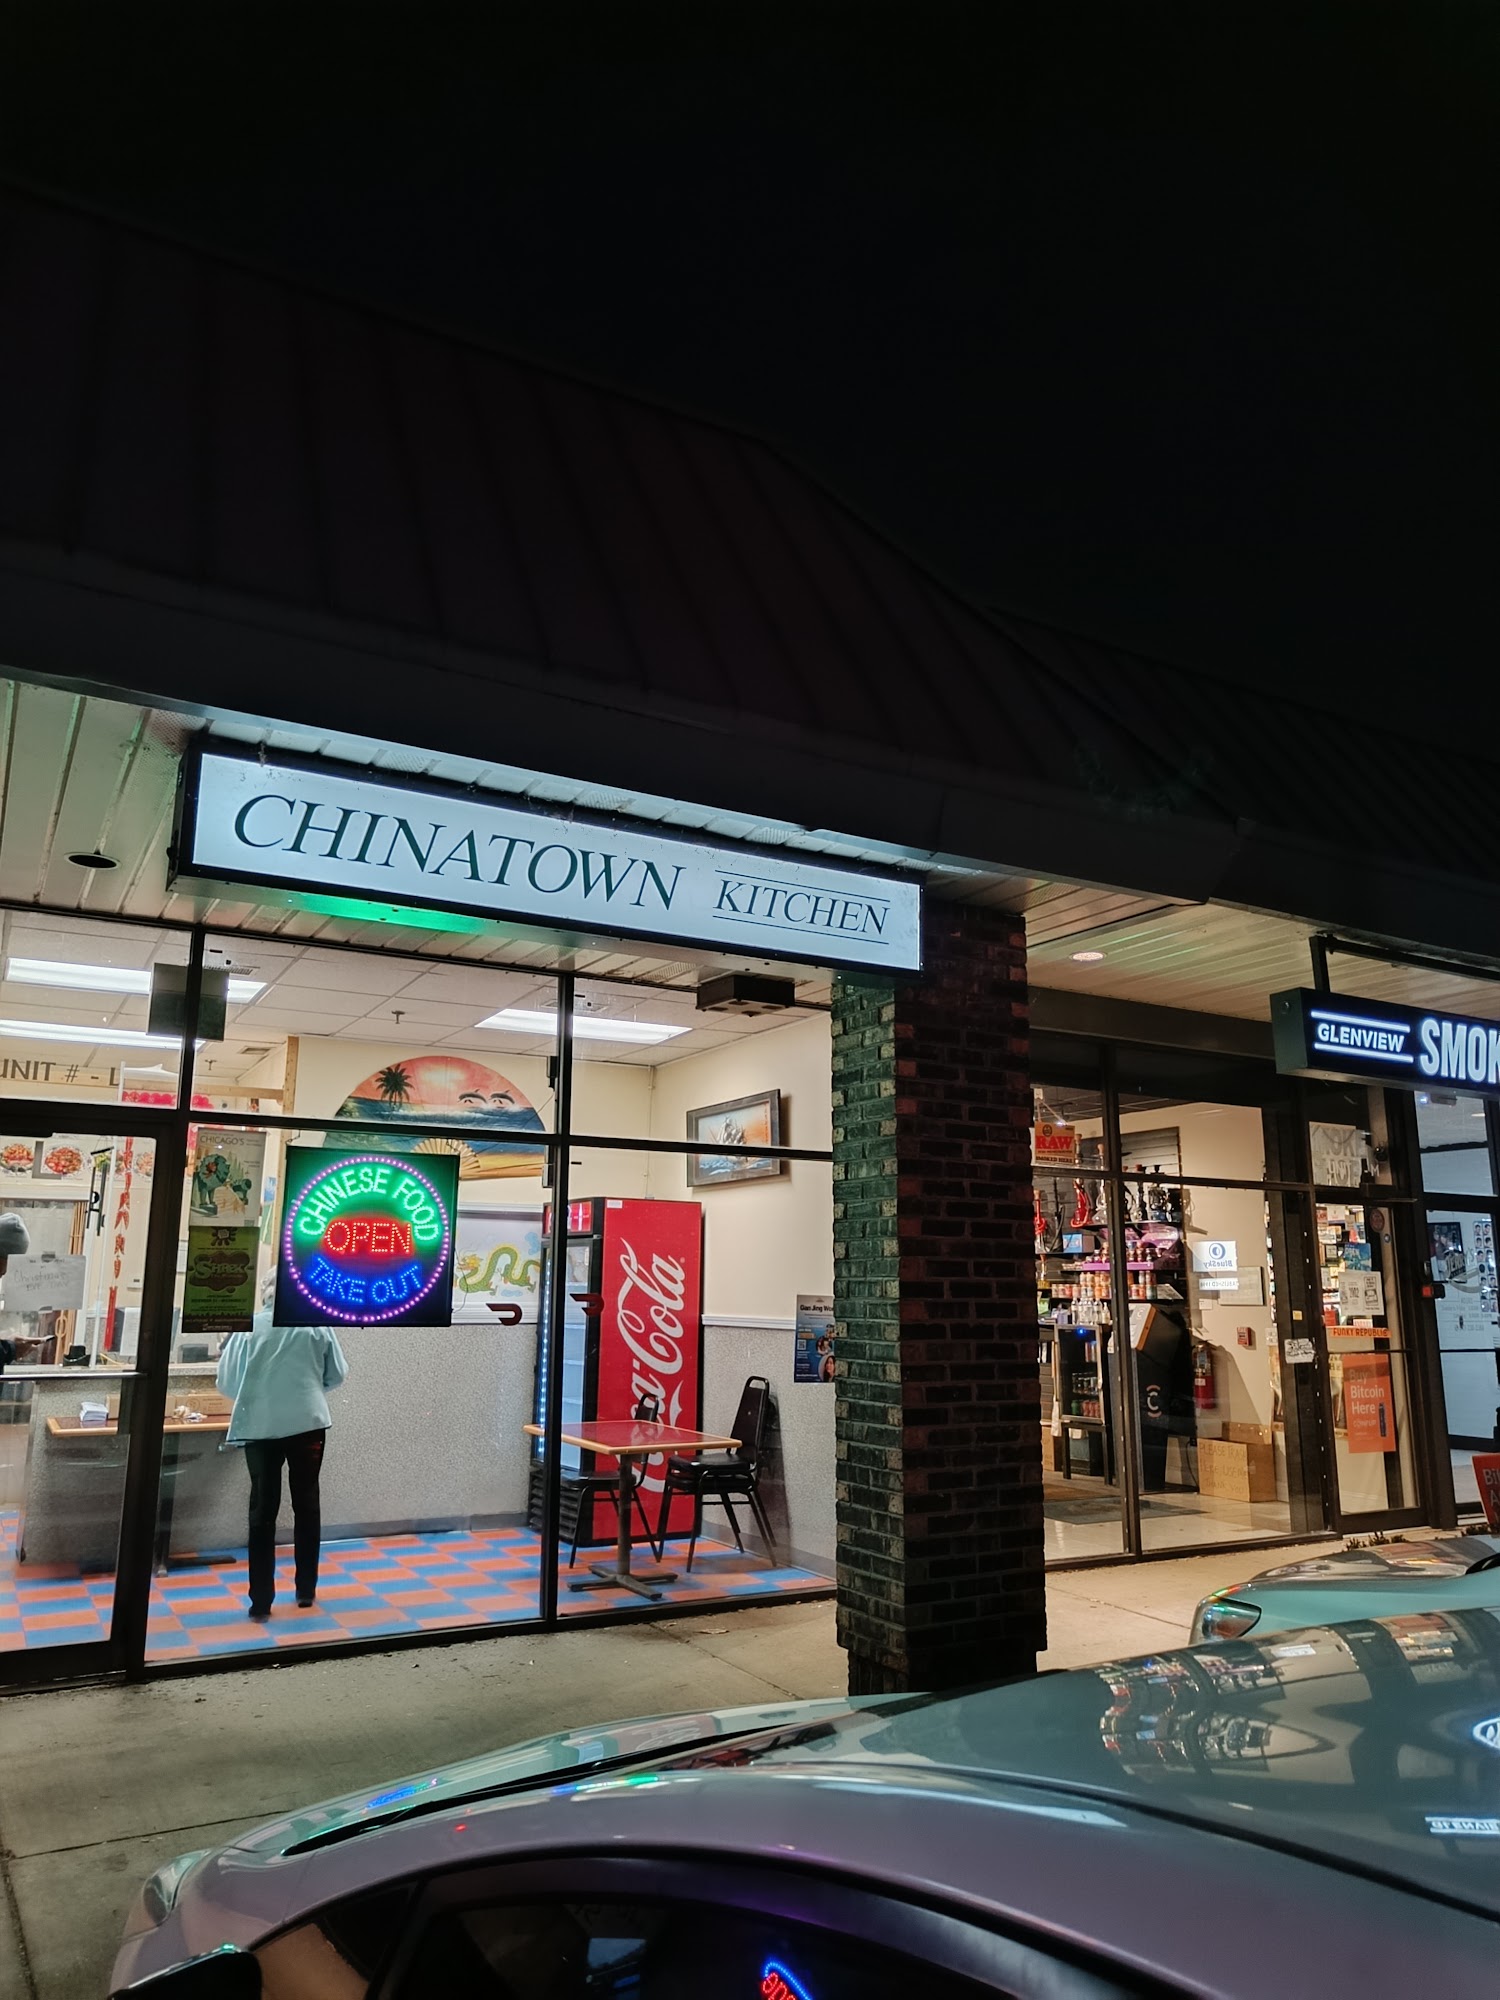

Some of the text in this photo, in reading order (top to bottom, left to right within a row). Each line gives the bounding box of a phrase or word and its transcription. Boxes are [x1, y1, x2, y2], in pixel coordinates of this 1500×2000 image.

[234, 794, 891, 935] CHINATOWN KITCHEN
[1317, 1023, 1405, 1053] GLENVIEW
[200, 1135, 245, 1146] CHICAGO'S
[1036, 1136, 1075, 1150] RAW
[299, 1167, 440, 1241] CHINESE FOOD
[326, 1221, 412, 1253] OPEN
[309, 1256, 422, 1304] TAKE OUT
[1333, 1328, 1389, 1337] FUNKY REPUBLIC
[1349, 1369, 1368, 1385] Buy
[1350, 1385, 1385, 1399] Bitcoin
[1351, 1401, 1376, 1415] Here
